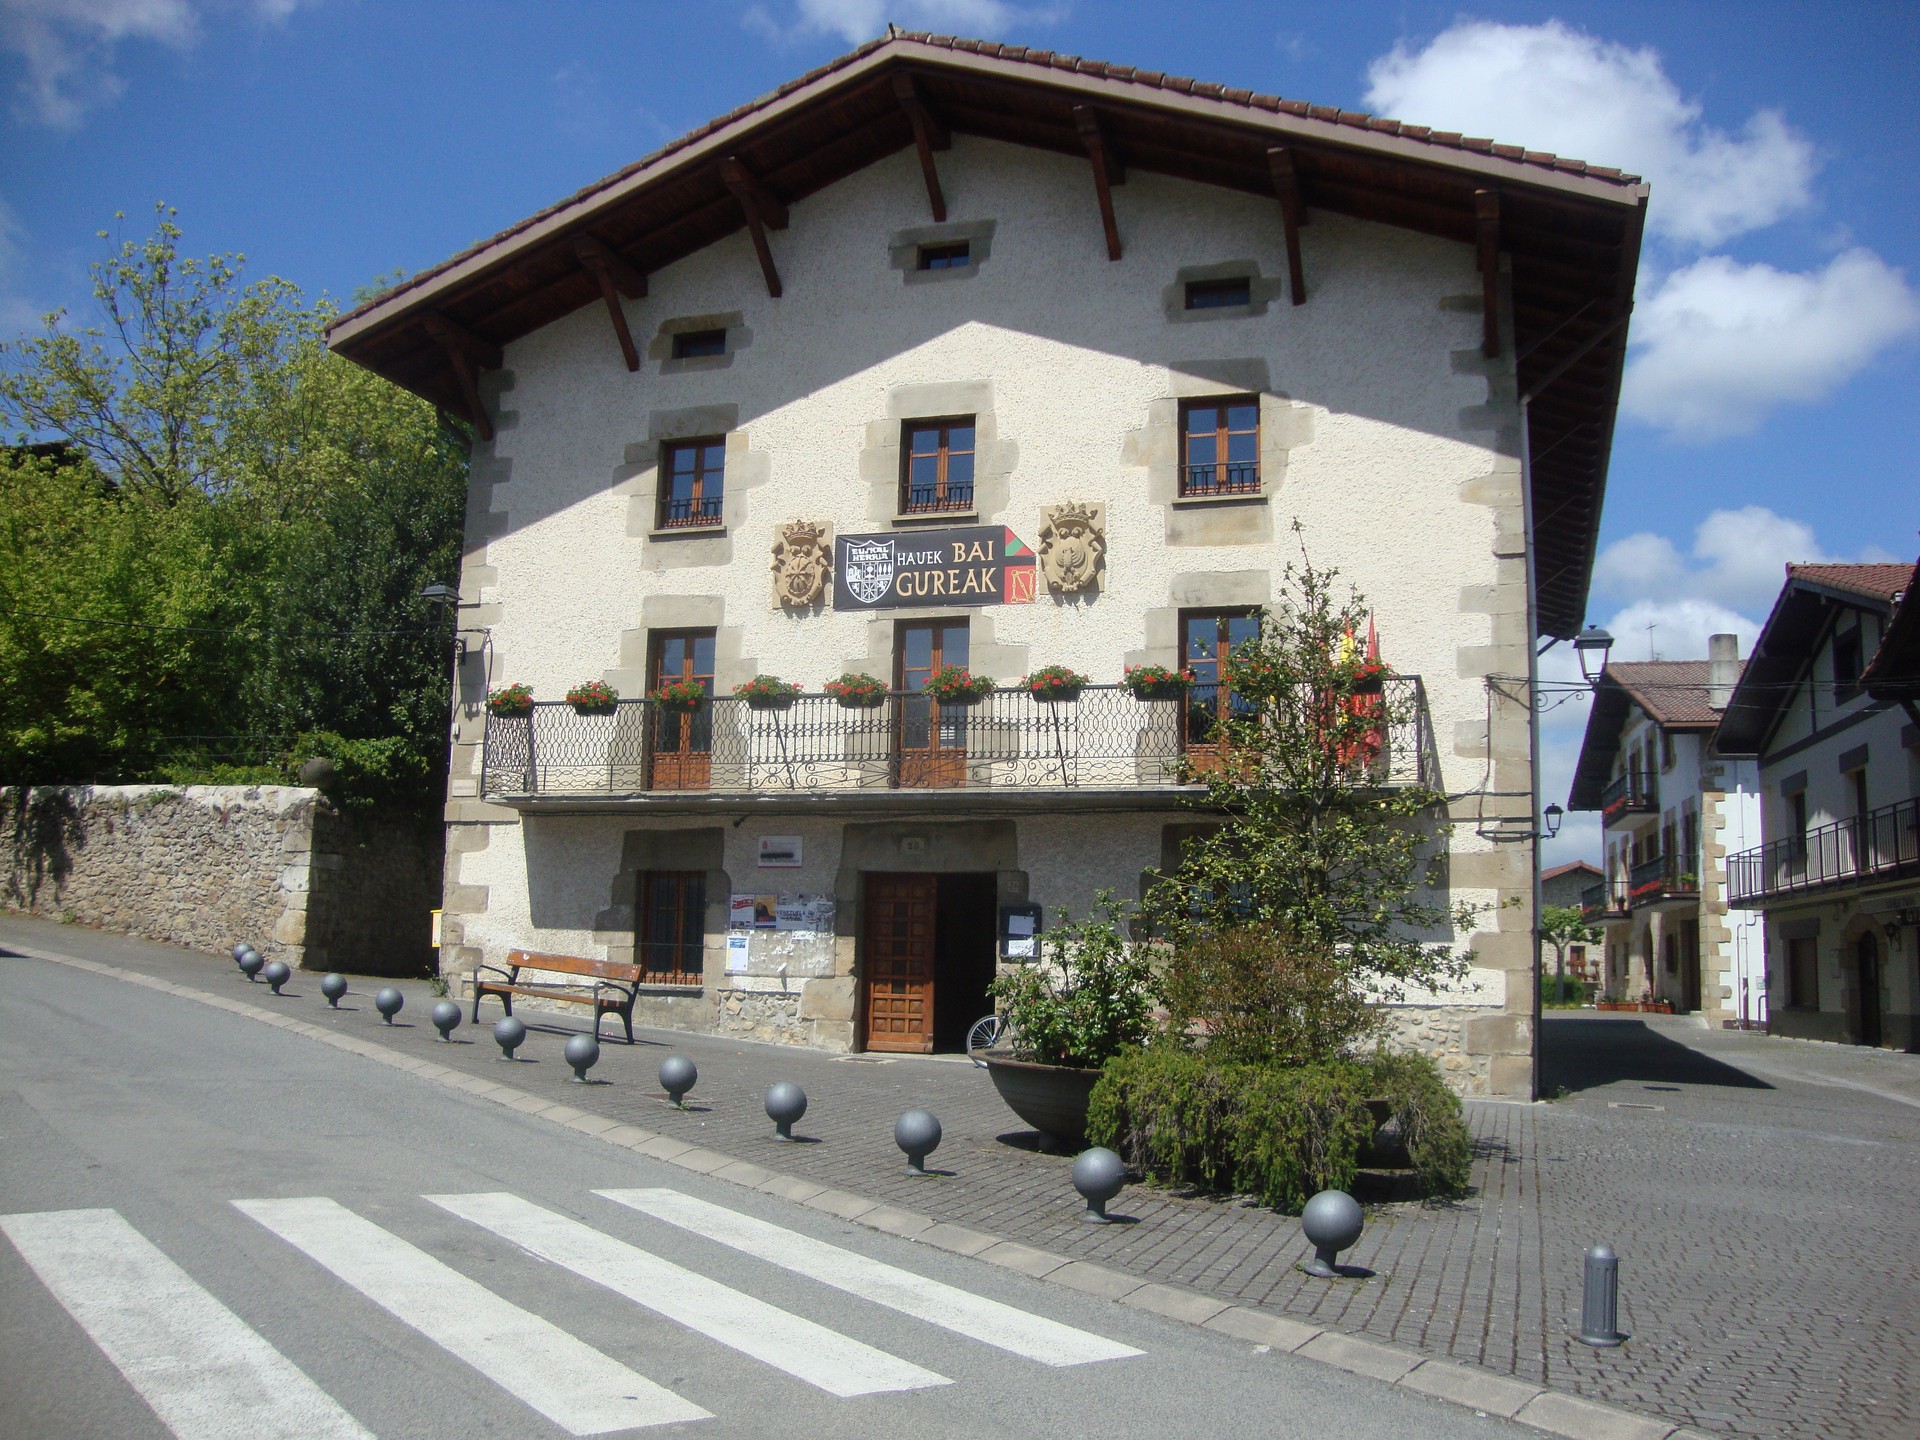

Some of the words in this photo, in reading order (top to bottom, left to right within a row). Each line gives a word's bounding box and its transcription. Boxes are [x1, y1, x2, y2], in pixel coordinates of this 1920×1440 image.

[897, 550, 943, 566] HAUEK
[951, 540, 995, 563] BAI
[895, 567, 997, 597] GUREAK
